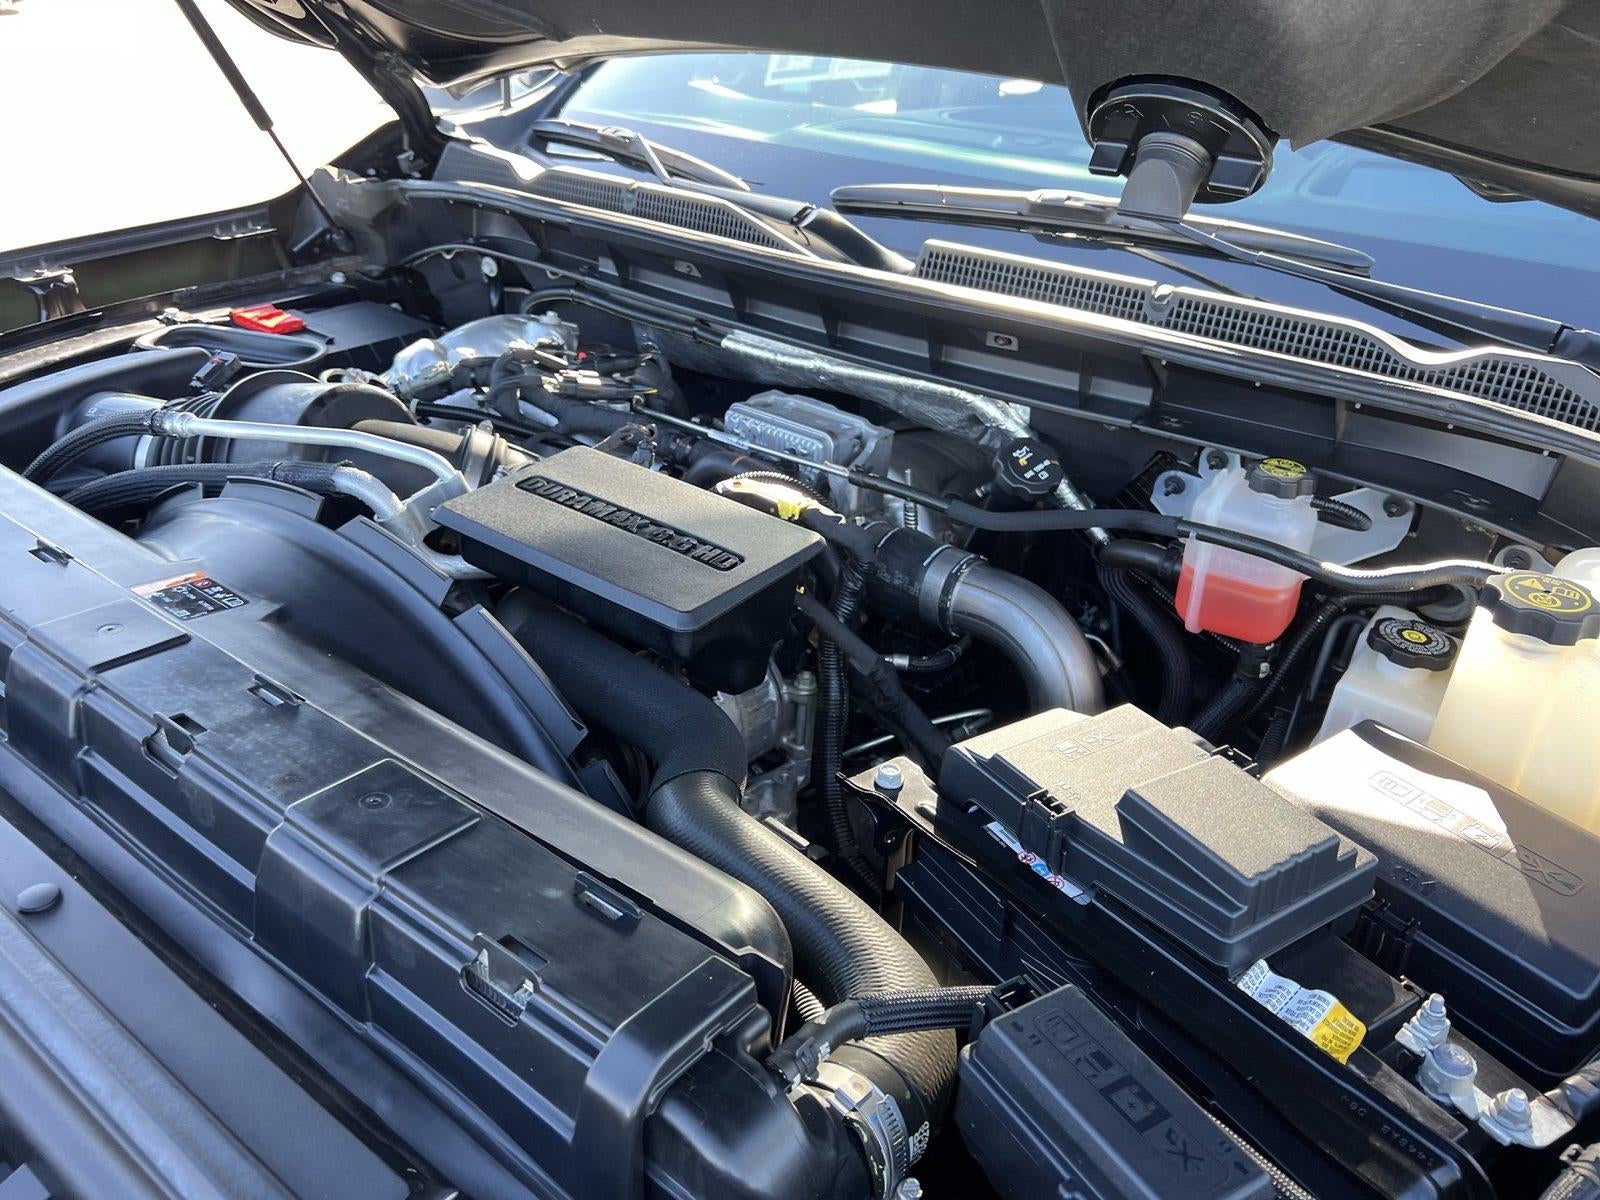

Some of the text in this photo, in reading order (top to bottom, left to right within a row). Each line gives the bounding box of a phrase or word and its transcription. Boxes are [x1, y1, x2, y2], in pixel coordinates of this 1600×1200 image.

[520, 477, 739, 571] DURAMAX 6.6 HD
